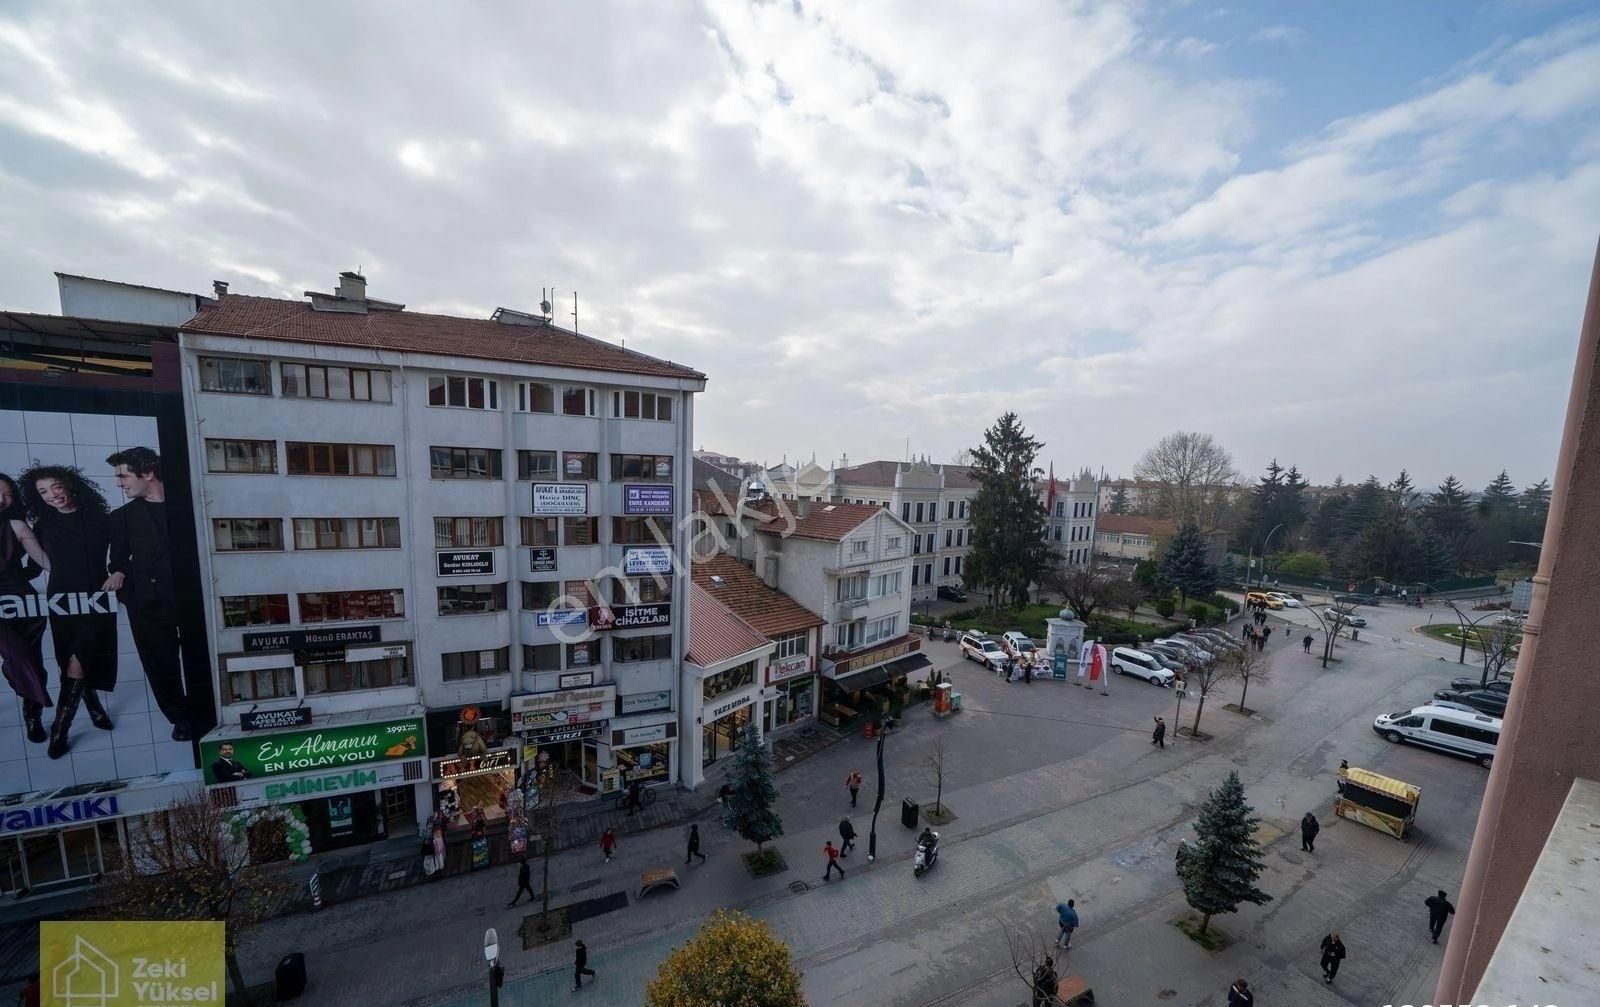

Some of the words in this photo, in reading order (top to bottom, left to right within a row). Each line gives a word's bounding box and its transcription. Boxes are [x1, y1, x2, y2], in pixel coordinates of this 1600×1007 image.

[625, 607, 657, 617] İŞİTME
[615, 614, 668, 626] CİHAZLARI
[252, 636, 290, 647] AVUKAT
[255, 710, 298, 721] AVUKAT
[257, 741, 284, 761] Ev
[290, 734, 379, 756] Almanın
[264, 762, 283, 773] EN
[289, 755, 335, 769] KOLAY
[338, 750, 375, 763] YOLU
[265, 769, 377, 799] EMİNEVİM
